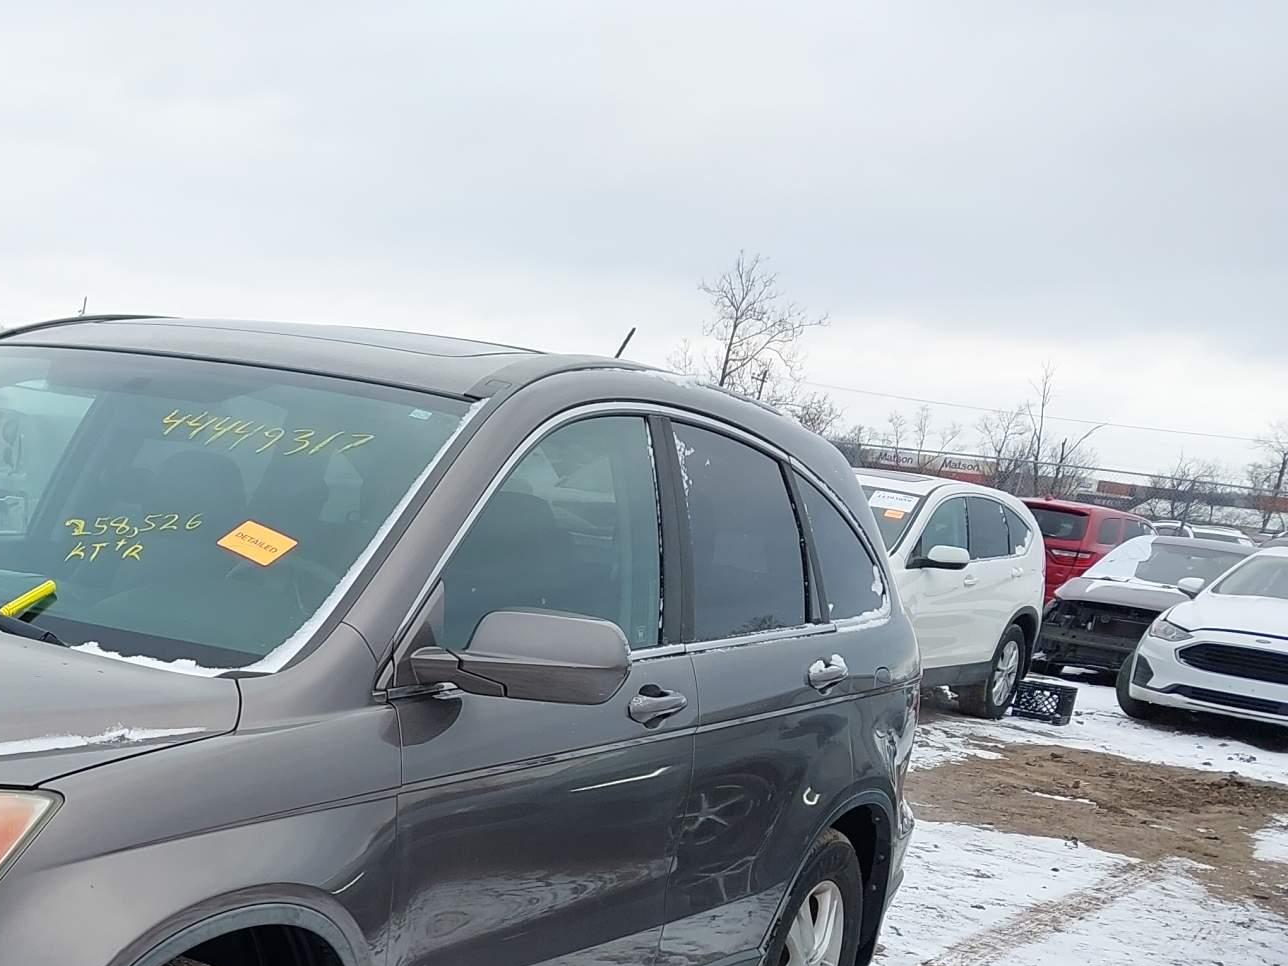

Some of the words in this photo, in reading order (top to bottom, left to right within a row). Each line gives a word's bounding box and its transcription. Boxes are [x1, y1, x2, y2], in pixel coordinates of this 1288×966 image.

[162, 408, 376, 456] 44449317
[942, 457, 980, 471] Matson
[235, 531, 279, 554] DETAILED
